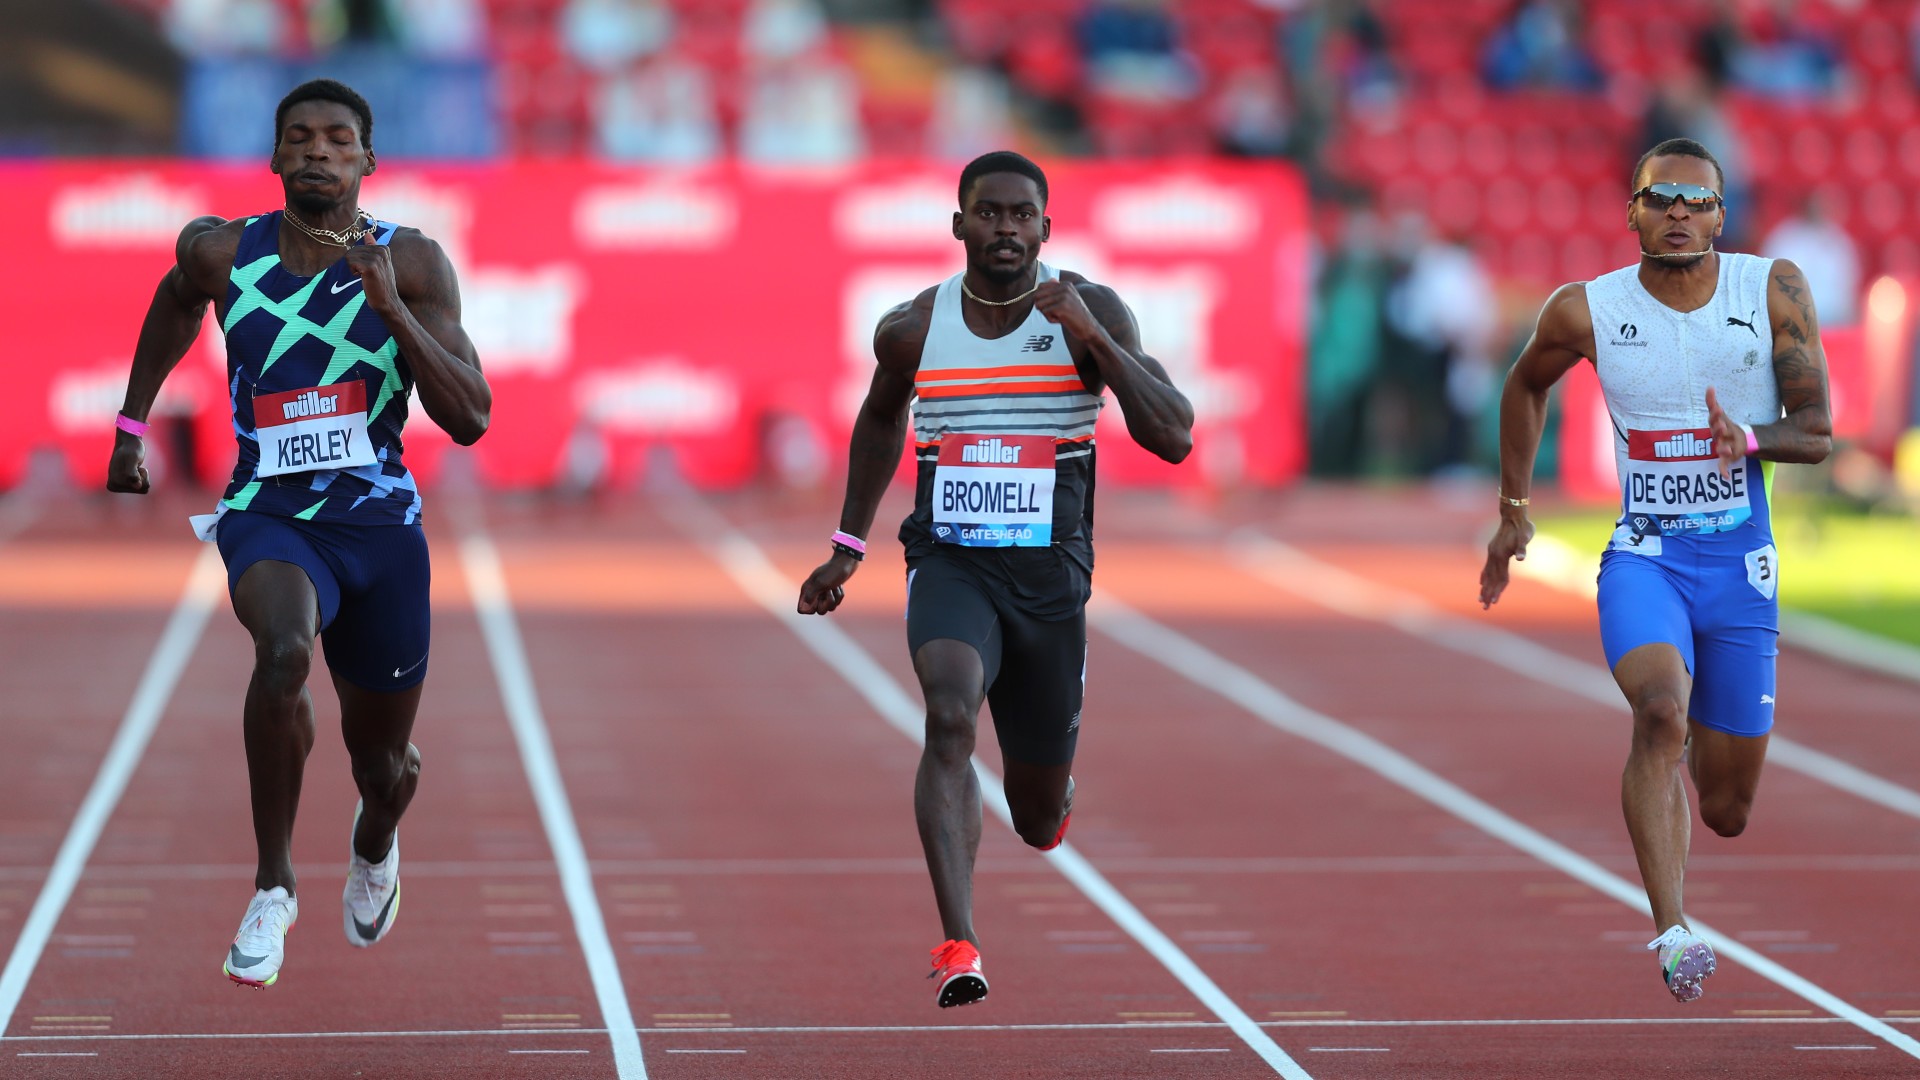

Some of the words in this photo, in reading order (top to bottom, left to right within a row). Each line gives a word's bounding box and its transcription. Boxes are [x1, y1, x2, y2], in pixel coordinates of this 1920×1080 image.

[282, 390, 338, 420] müller
[277, 428, 352, 468] KERLEY
[961, 438, 1022, 464] müller
[1653, 432, 1713, 458] müller
[943, 480, 1040, 513] BROMELL
[1632, 472, 1657, 504] DE
[1661, 468, 1744, 504] GRASSE
[961, 528, 1032, 540] GATESHEAD
[1660, 515, 1734, 530] GATESHEAD
[1757, 555, 1771, 581] 3
